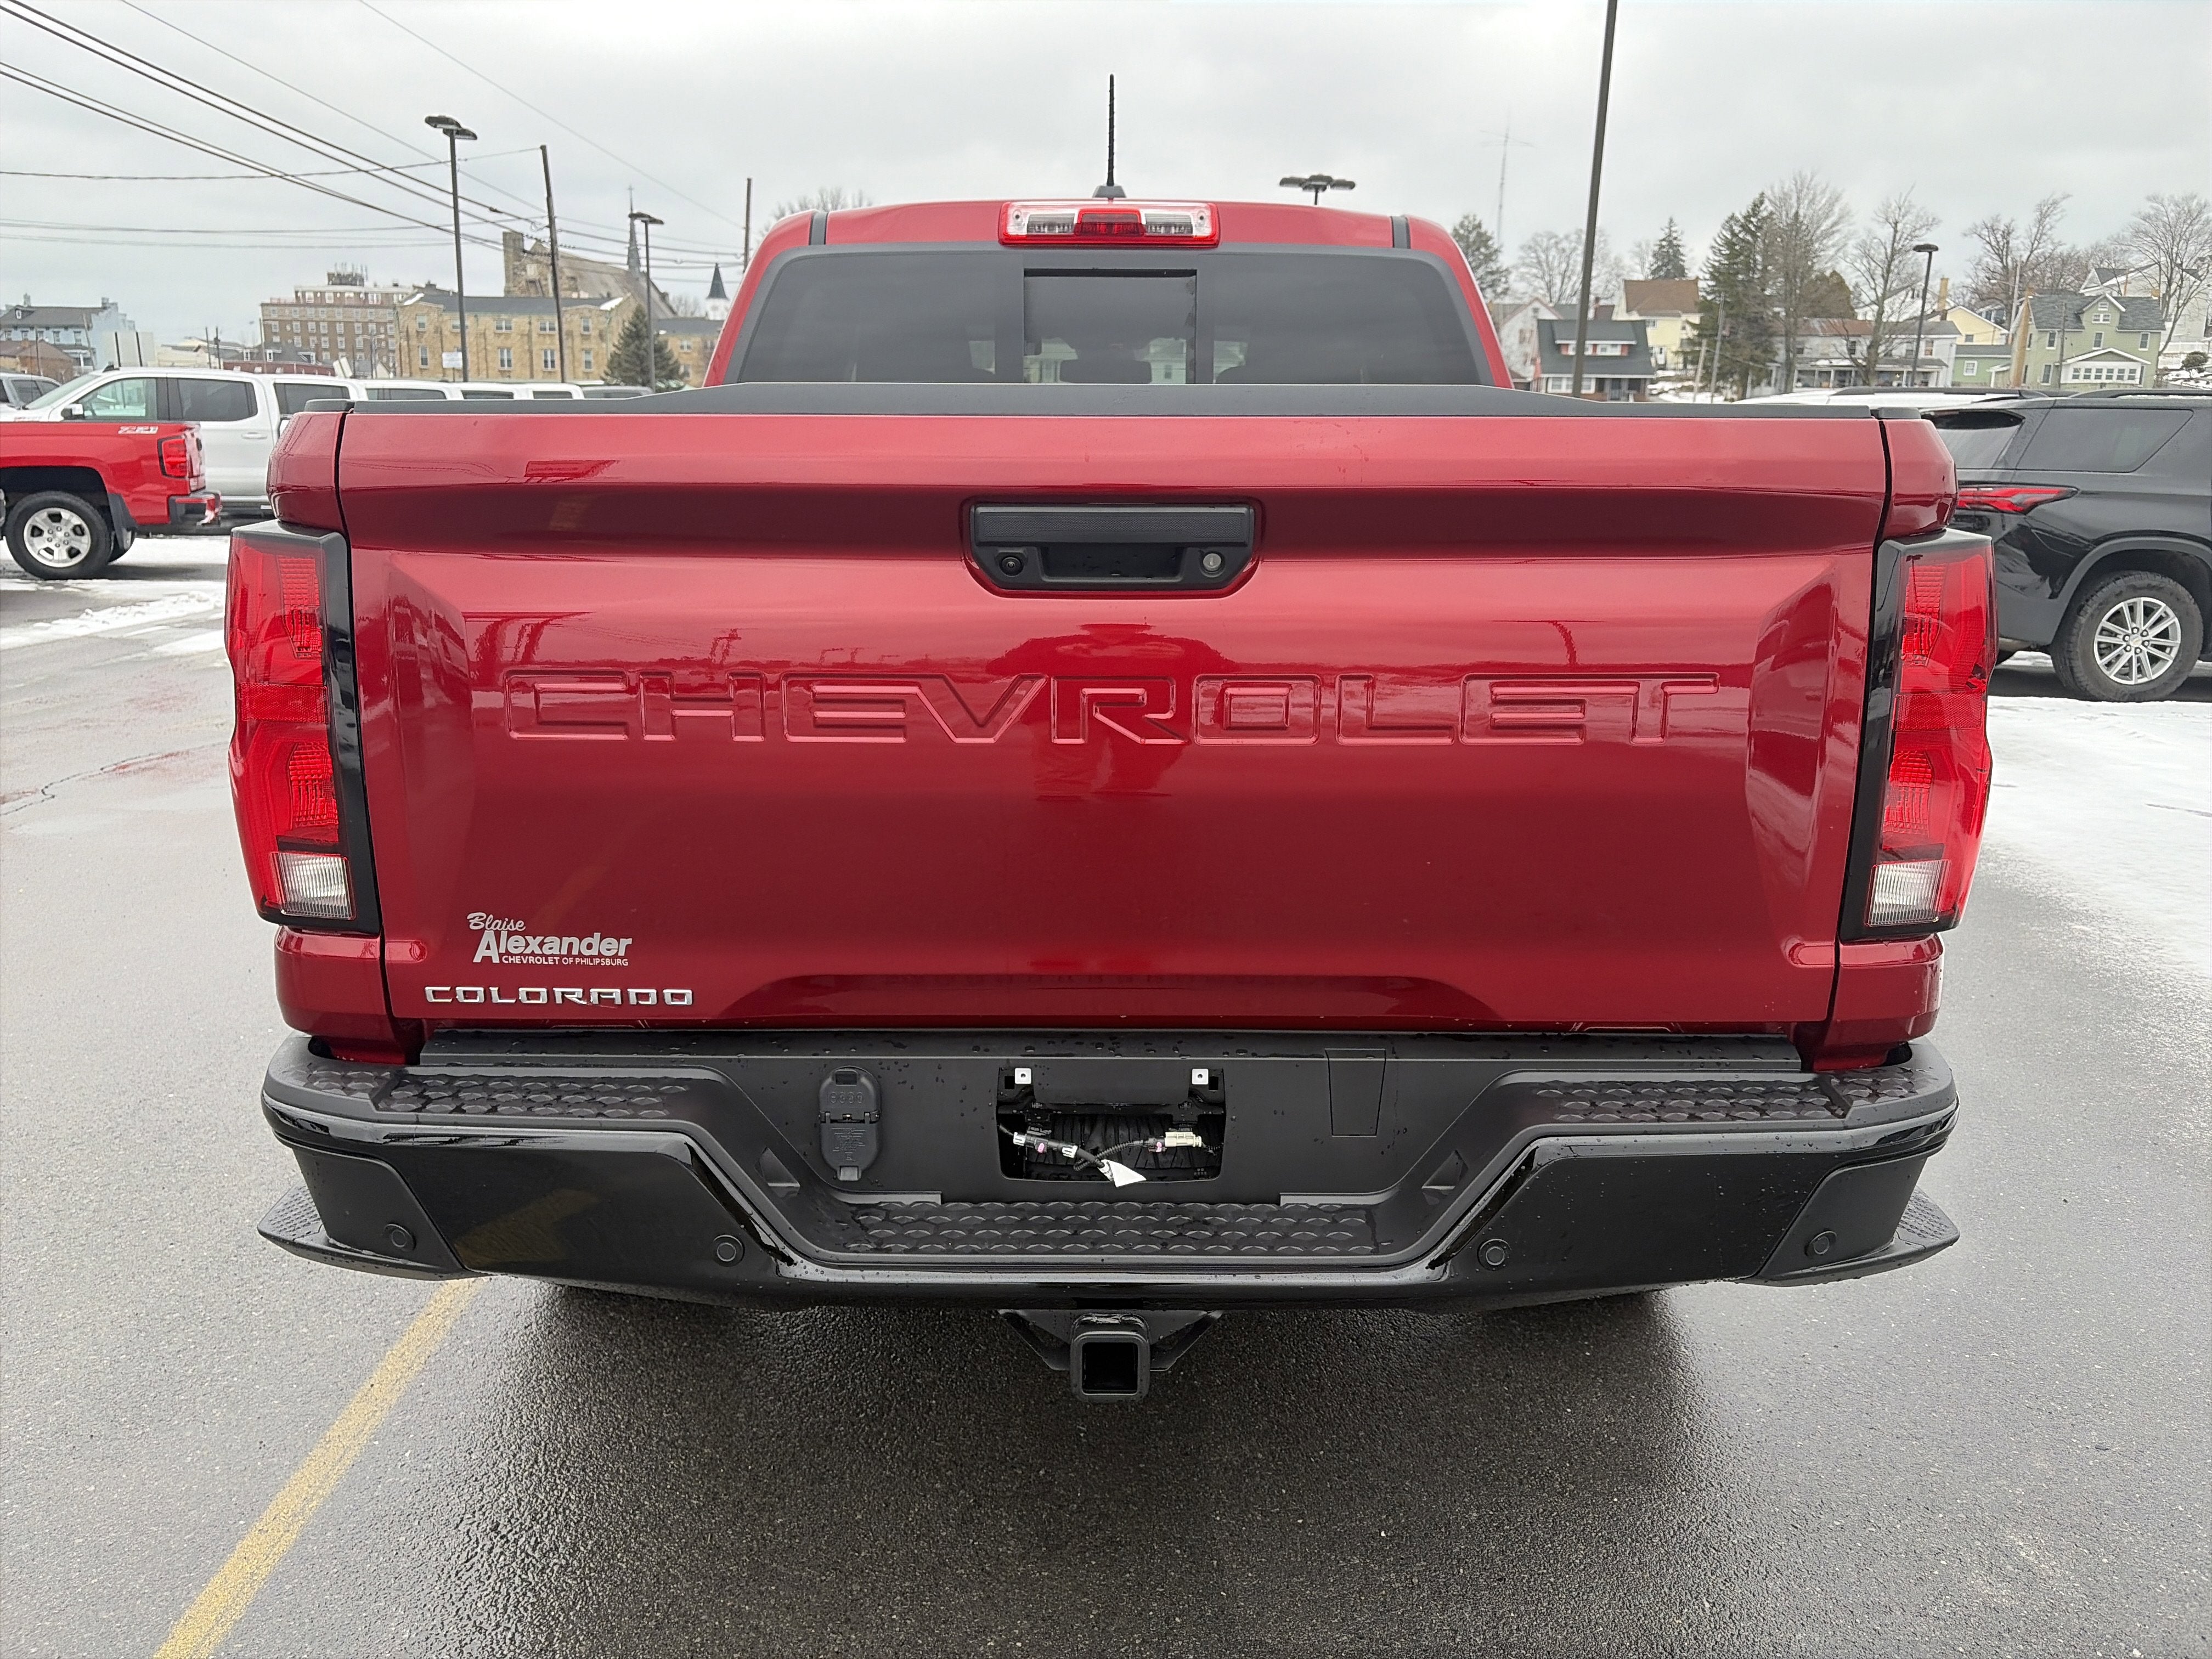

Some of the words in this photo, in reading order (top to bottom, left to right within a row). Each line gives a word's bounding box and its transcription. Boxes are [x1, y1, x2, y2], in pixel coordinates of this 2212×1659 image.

[504, 669, 1719, 745] CHEVROLET
[467, 912, 526, 932] Blaise
[473, 930, 633, 963] Alexander
[501, 955, 560, 965] CHEVROLET
[563, 957, 574, 965] OF
[575, 957, 629, 966] PHILIPSBURG
[425, 986, 693, 1006] COLORADO
